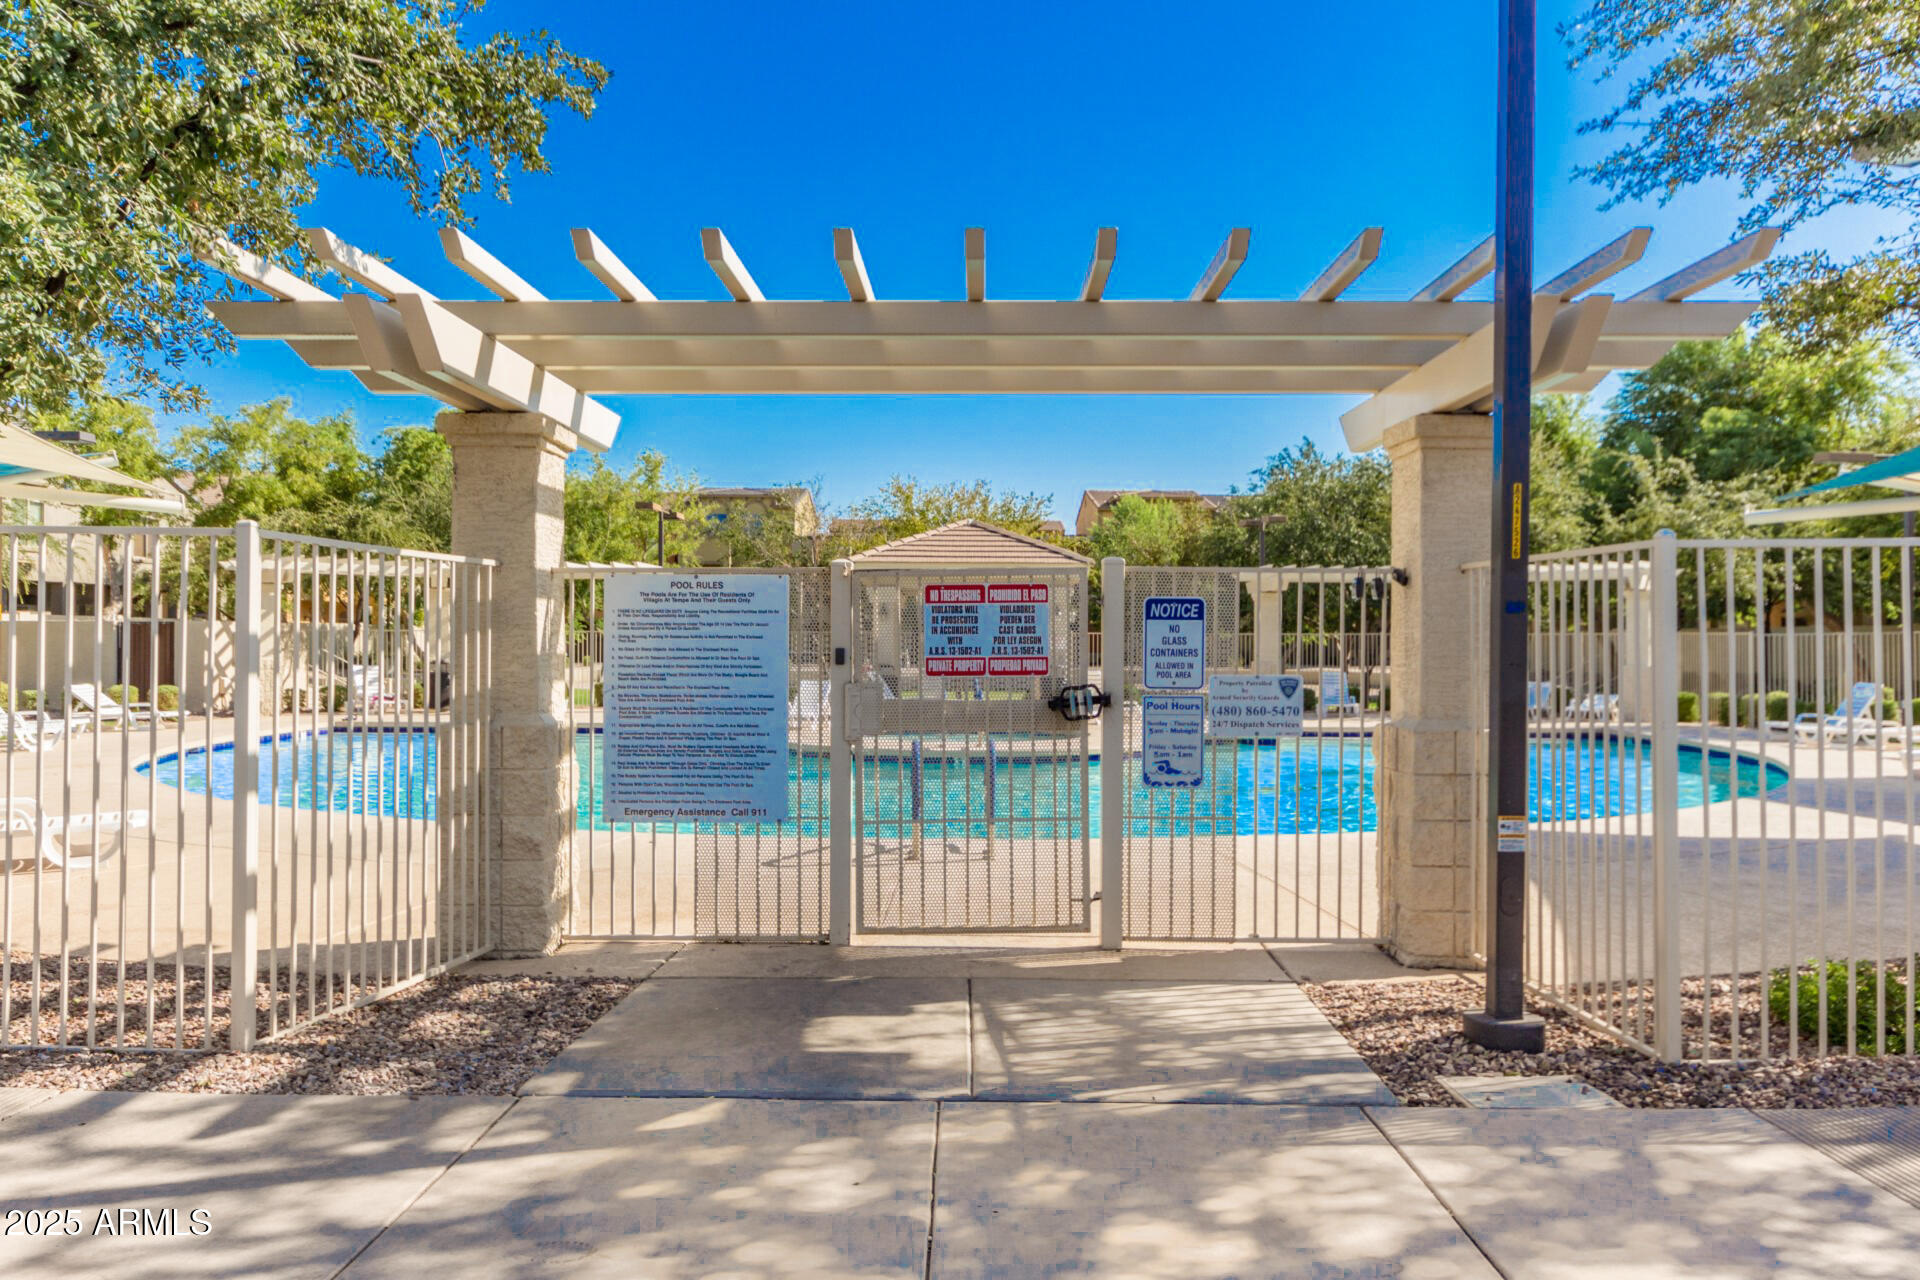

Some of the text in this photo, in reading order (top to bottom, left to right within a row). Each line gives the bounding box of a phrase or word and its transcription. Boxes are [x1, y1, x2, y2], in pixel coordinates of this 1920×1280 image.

[670, 581, 724, 589] POOL RULES
[929, 589, 982, 601] NO TRESPASSING
[990, 589, 1046, 601] PROHIBIDO EL PASO
[931, 605, 978, 613] VIOLATORS WILL
[1000, 605, 1036, 613] VIOLADORES
[1150, 603, 1200, 618] NOTICE
[932, 616, 978, 624] BE PROSECUTED
[1000, 616, 1035, 624] PUEDEN SER
[932, 626, 978, 634] IN ACCORDANCE
[1168, 624, 1180, 633] NO
[948, 636, 962, 645] WITH
[994, 636, 1042, 644] POR LEY ASEGUN
[1161, 636, 1187, 645] GLASS
[949, 647, 981, 655] 13-1502-A1
[992, 646, 1043, 655] A.R.S. 13-1502-A1
[1150, 648, 1199, 657] CONTAINERS
[928, 660, 984, 672] PRIVATE PROPERTY
[1022, 660, 1046, 671] PRIVADA
[1147, 702, 1200, 710] Pool Hours
[1212, 706, 1300, 716] (480) 860-5470
[624, 808, 767, 817] Emergency Assistance Call 911
